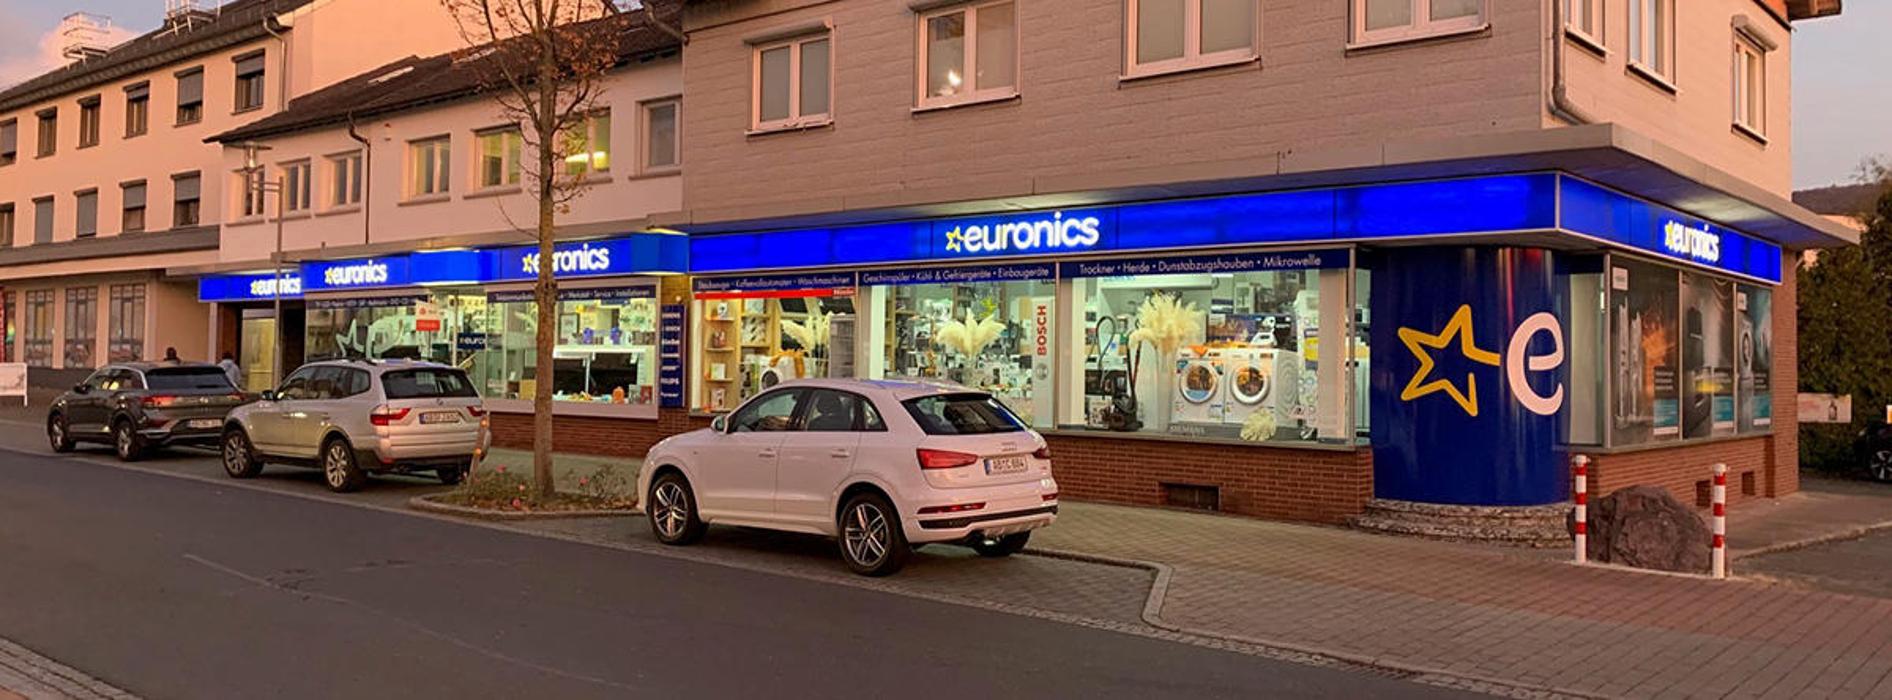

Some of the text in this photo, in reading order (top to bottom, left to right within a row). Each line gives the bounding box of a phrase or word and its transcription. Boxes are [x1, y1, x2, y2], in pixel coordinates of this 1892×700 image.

[964, 211, 1099, 252] euronics
[1673, 222, 1719, 262] euronics
[333, 260, 387, 284] euronics
[533, 243, 609, 273] eronics
[998, 266, 1049, 279] Einbaugeräte
[1079, 254, 1322, 275] Trockner Herde Dunstabzugshauben Mikrowelle
[257, 273, 301, 295] euronics
[1037, 305, 1047, 356] BOSCH
[1507, 312, 1564, 415] e
